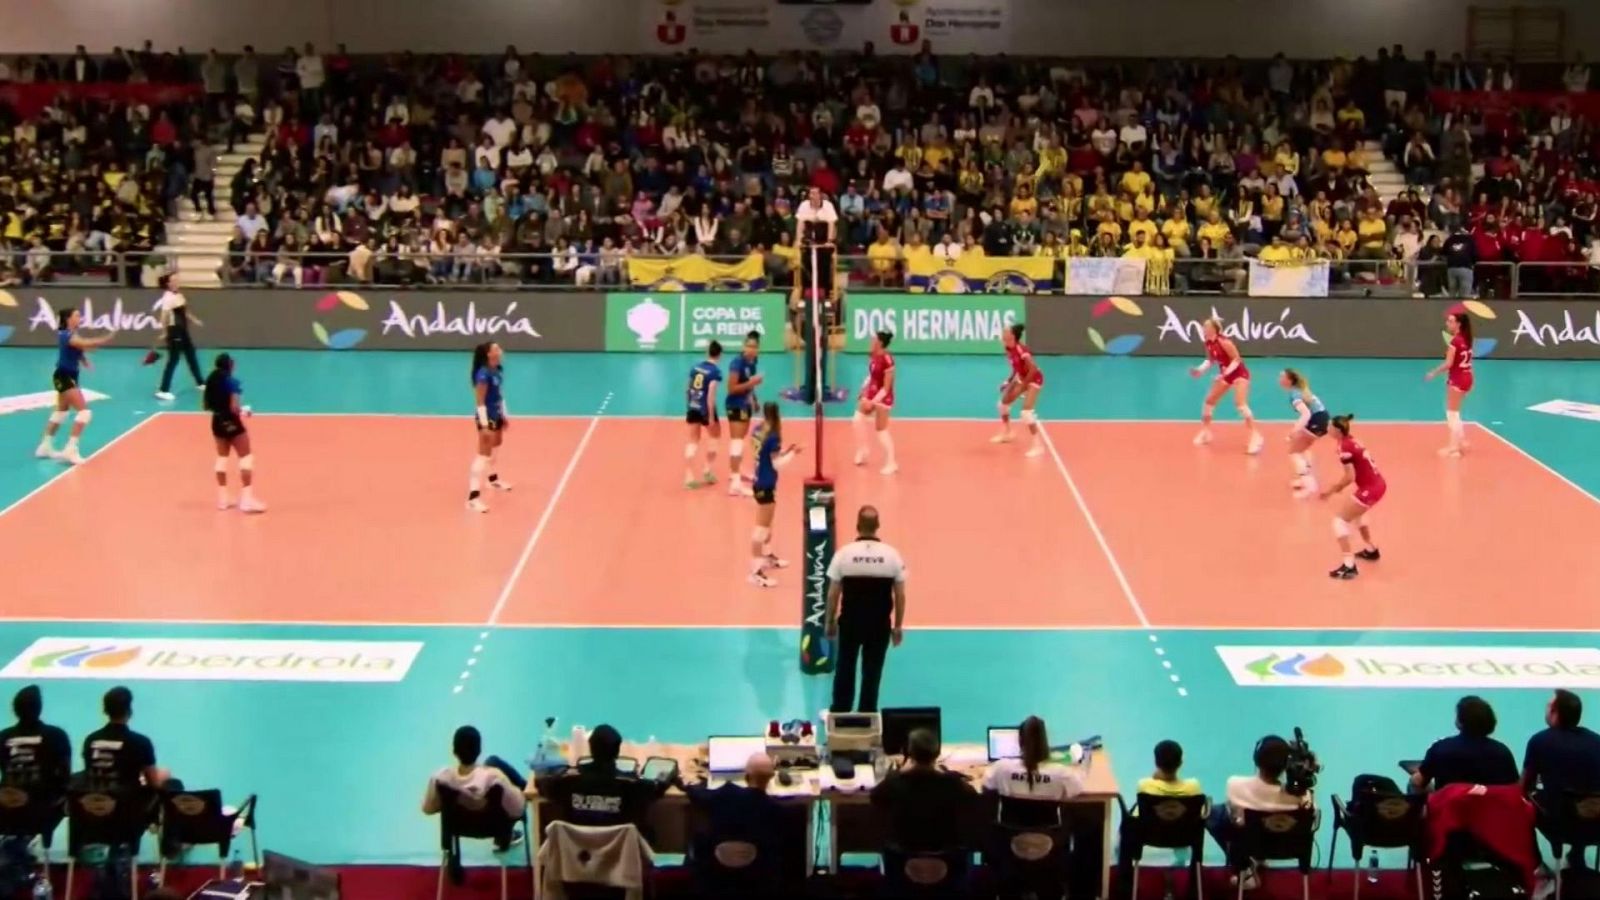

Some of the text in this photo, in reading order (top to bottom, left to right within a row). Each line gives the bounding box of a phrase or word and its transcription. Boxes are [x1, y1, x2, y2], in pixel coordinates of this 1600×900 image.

[30, 296, 164, 332] Adalucí
[382, 300, 542, 338] Andalucía
[692, 307, 761, 320] COPA DE
[854, 308, 897, 340] DOS
[692, 322, 765, 335] LA REINA
[693, 373, 705, 389] 8
[805, 539, 828, 627] Andalucía
[146, 650, 395, 671] Iberdrola
[1354, 657, 1600, 678] Iberdrola
[1011, 772, 1051, 783] RFVB
